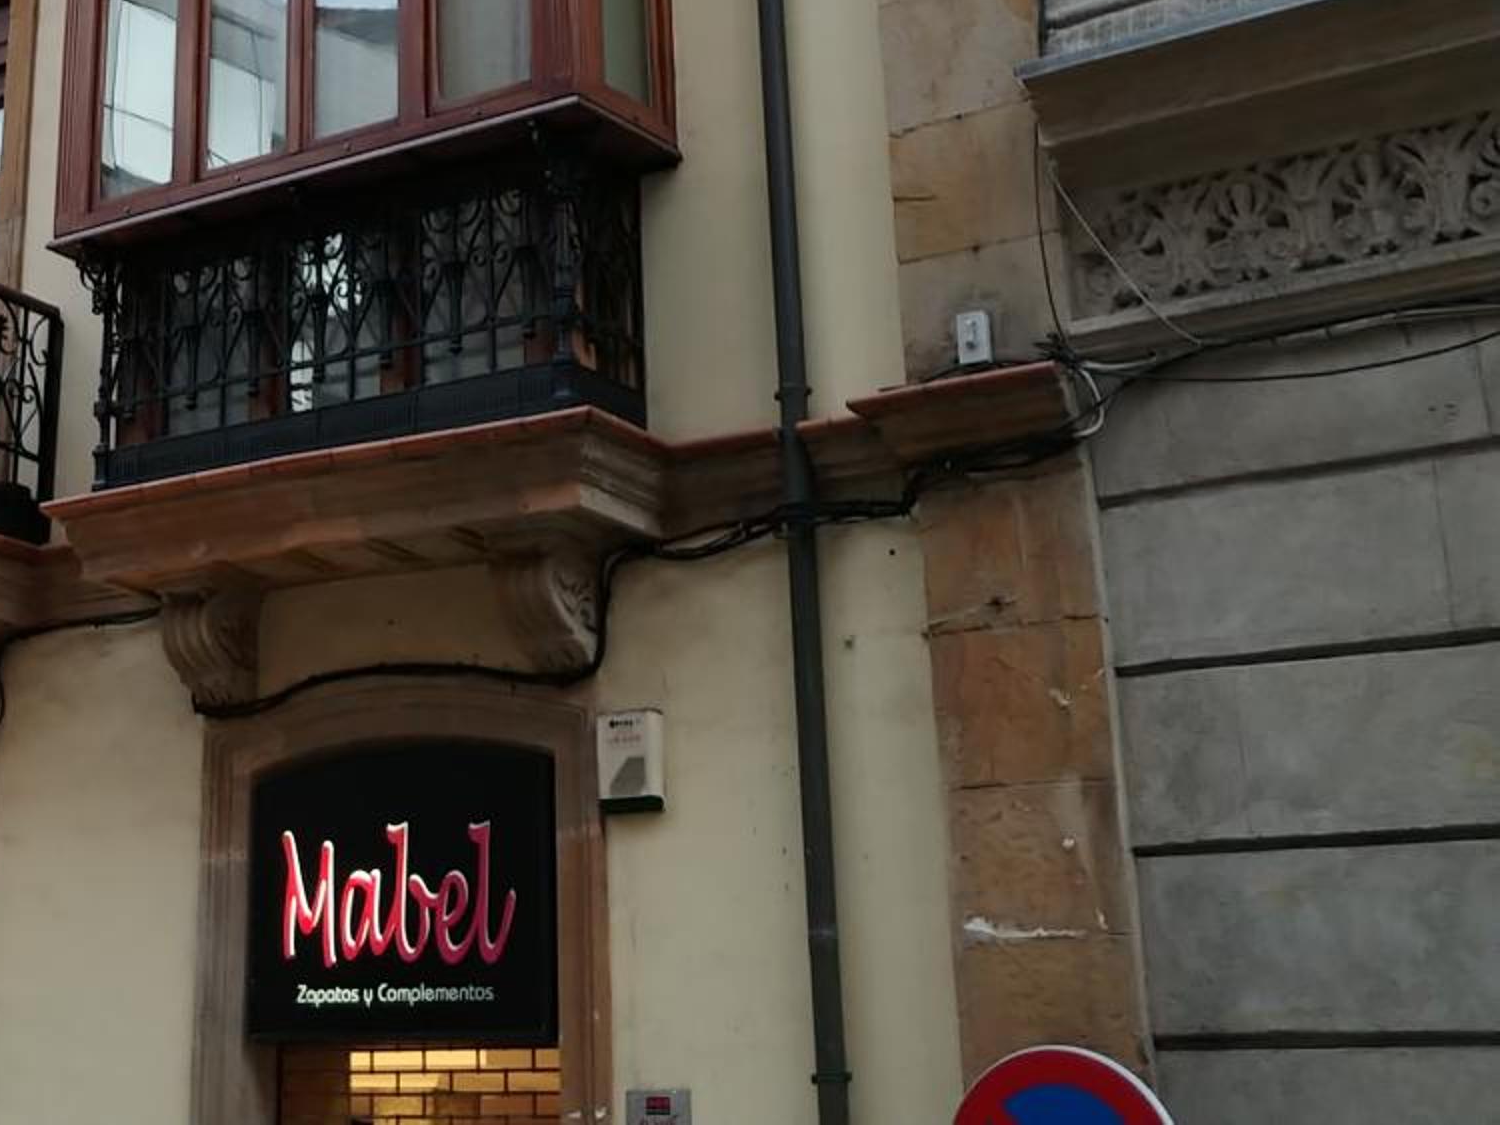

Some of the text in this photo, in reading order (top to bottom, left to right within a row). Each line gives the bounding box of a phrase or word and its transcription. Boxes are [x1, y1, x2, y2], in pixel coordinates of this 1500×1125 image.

[282, 821, 517, 968] Mabel
[296, 982, 495, 1009] Zapatos y Complementos
